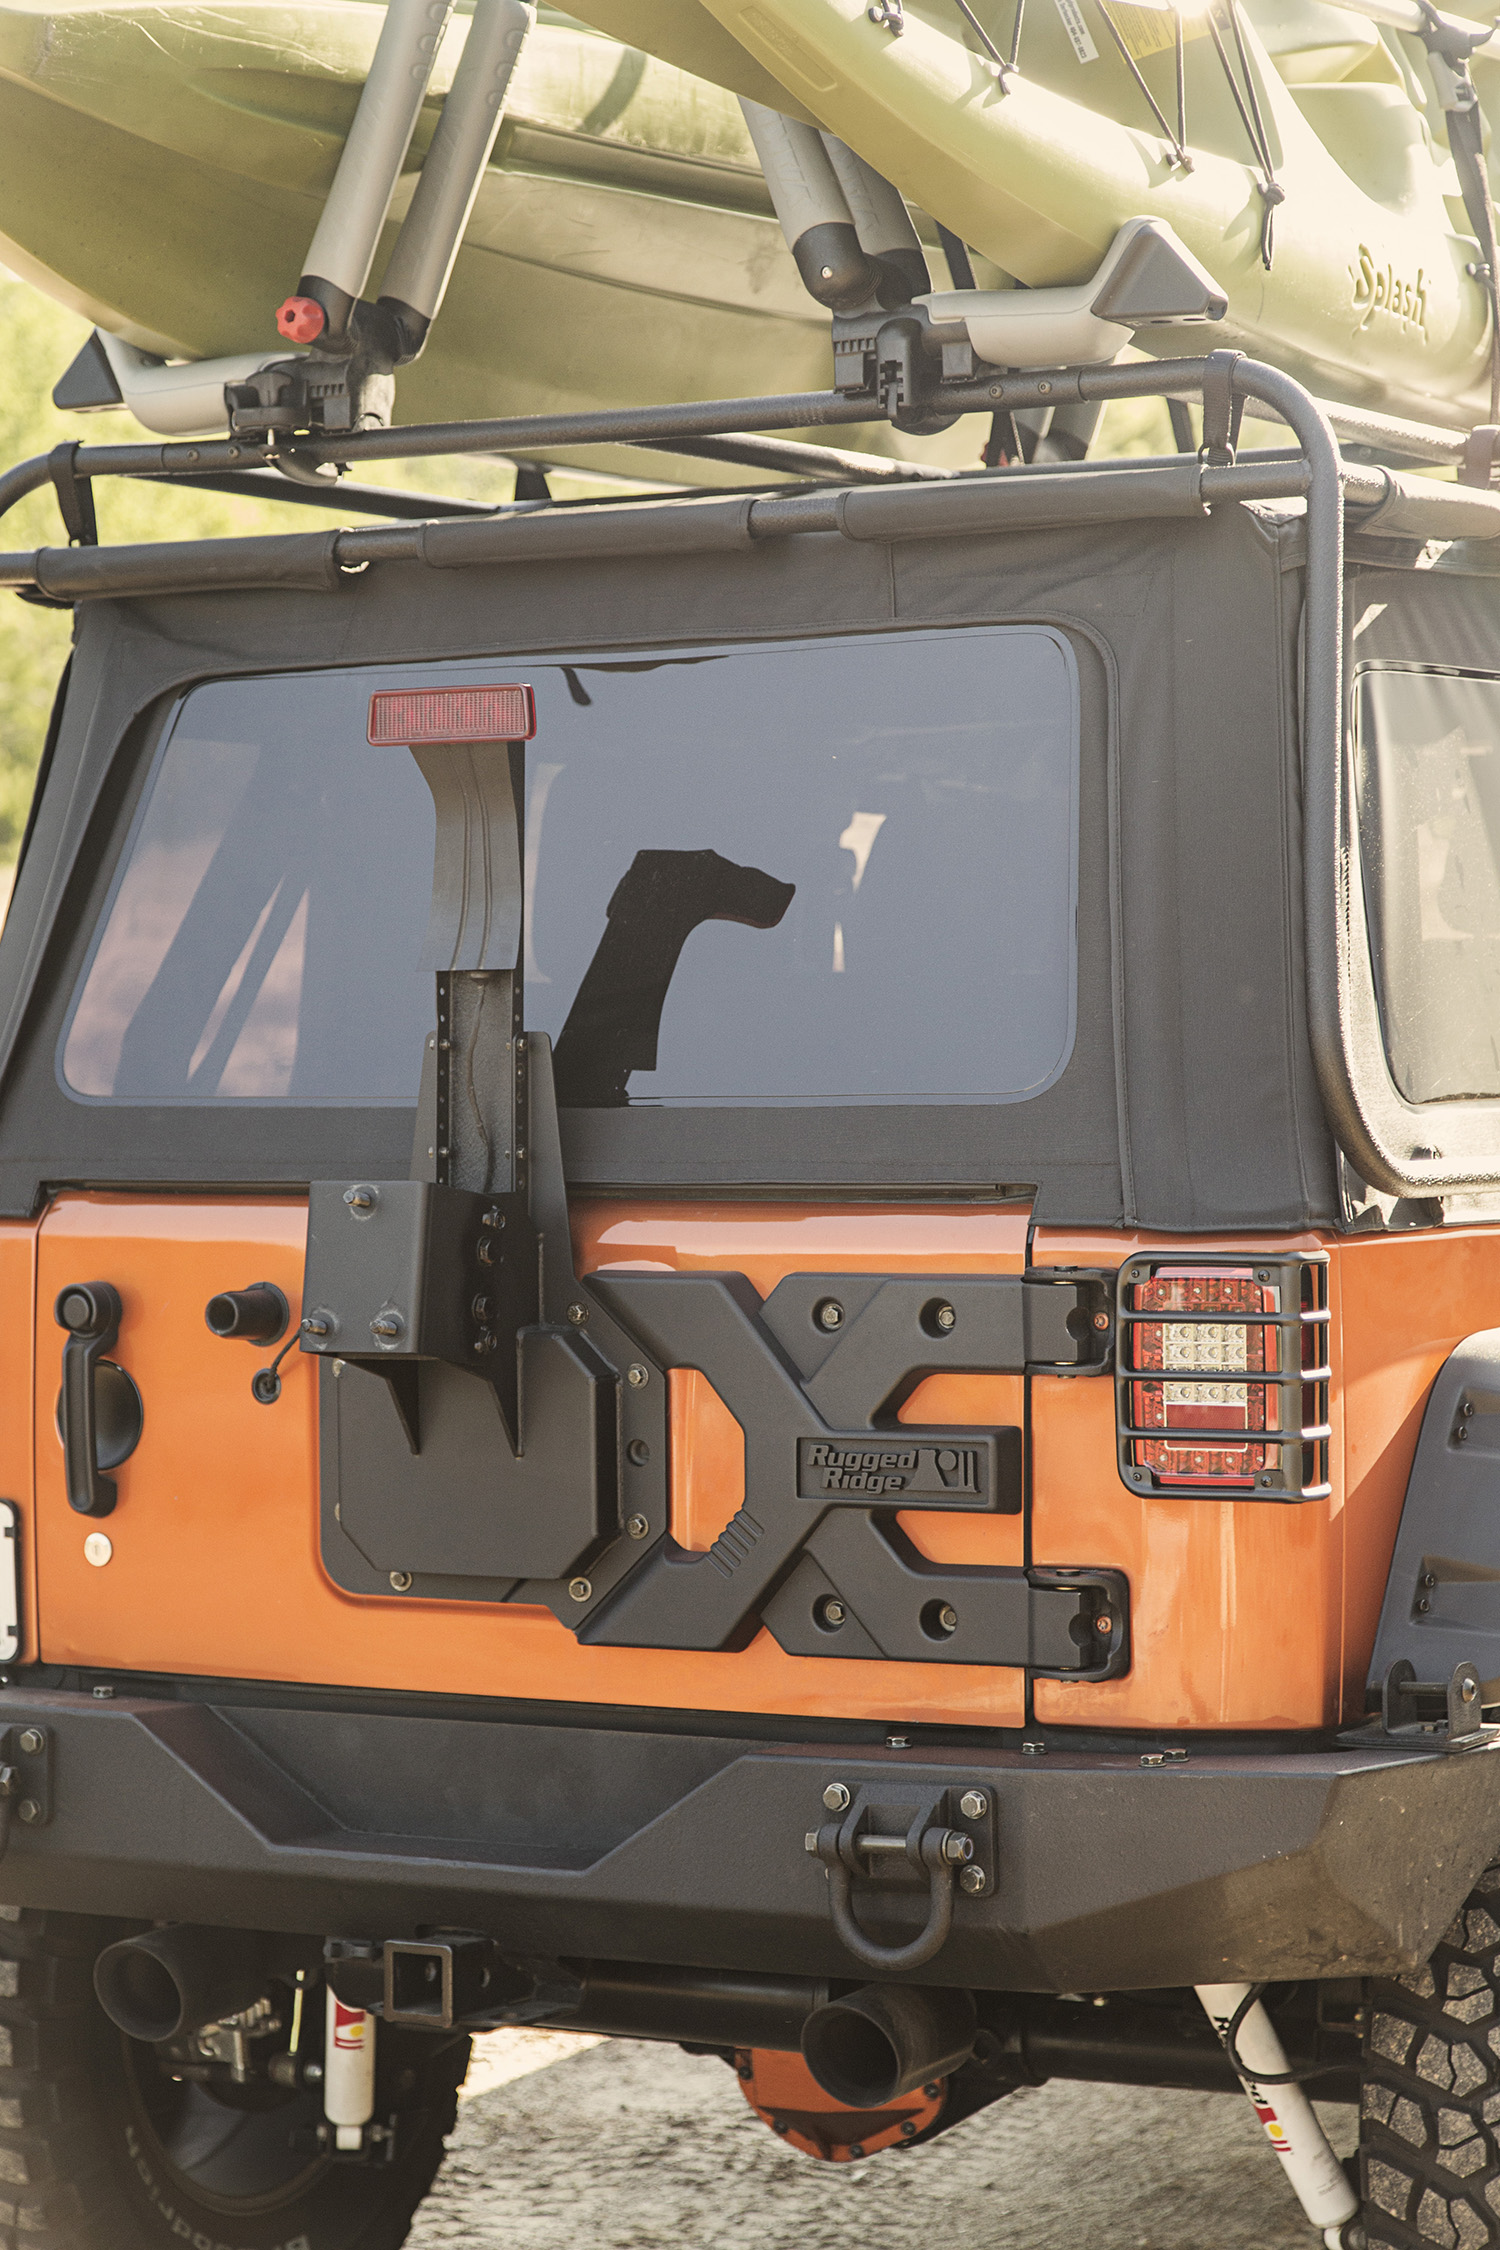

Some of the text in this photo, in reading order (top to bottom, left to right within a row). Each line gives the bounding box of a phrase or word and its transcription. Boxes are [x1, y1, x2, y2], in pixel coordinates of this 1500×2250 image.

[1350, 243, 1428, 342] Splash
[806, 1444, 916, 1471] Rugged
[820, 1467, 903, 1494] Ridge
